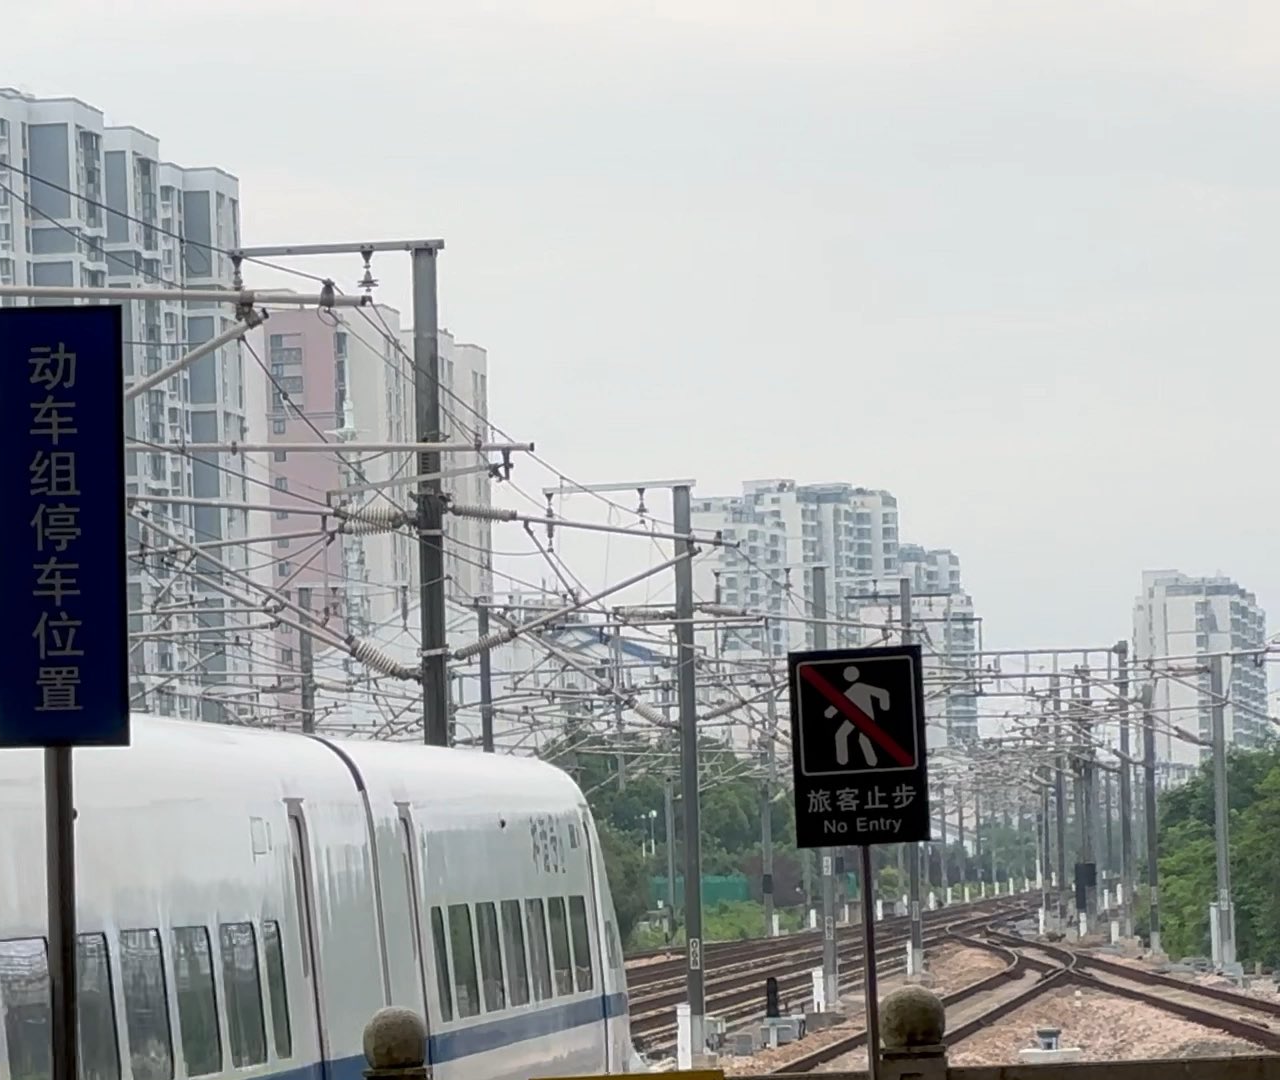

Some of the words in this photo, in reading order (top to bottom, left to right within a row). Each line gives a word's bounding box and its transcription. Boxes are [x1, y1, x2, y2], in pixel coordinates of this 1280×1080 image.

[27, 341, 85, 711] 动车组停车位置
[806, 783, 917, 814] 旅客止步
[823, 819, 848, 834] No
[856, 816, 903, 833] Entry
